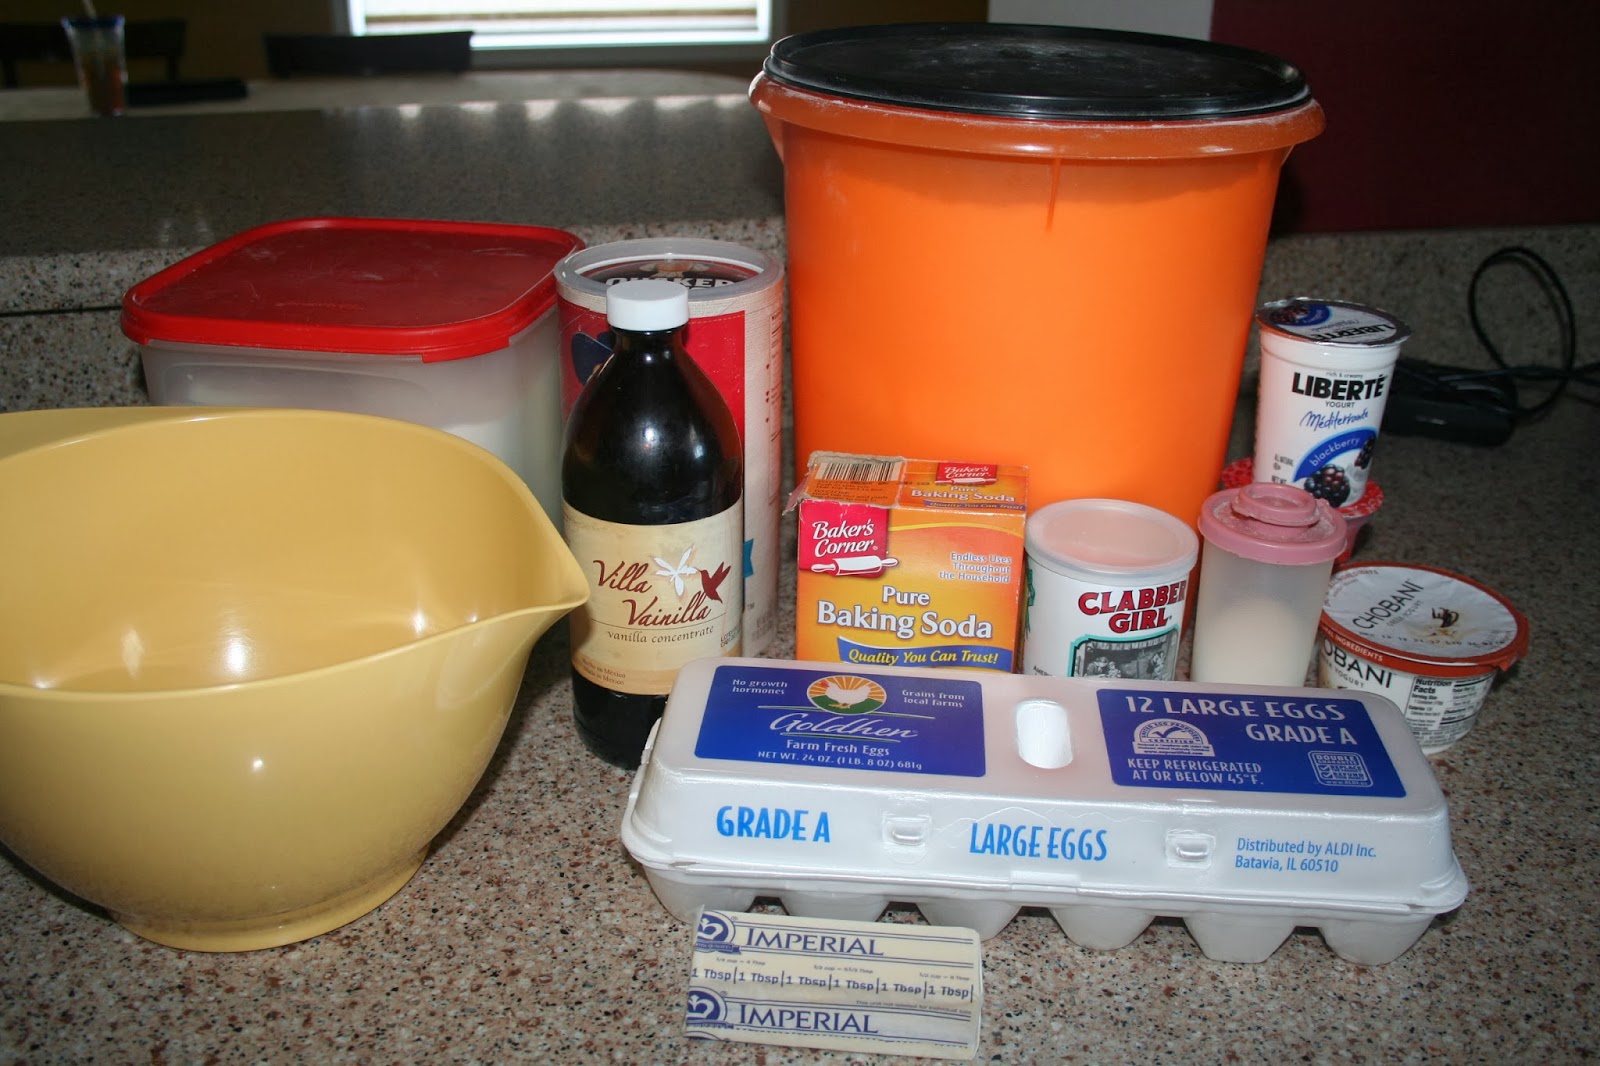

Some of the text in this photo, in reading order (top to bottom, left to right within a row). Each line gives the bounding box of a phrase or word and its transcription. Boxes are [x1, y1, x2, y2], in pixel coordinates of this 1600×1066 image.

[1291, 371, 1386, 400] LIBERTÉ
[1309, 438, 1360, 467] blackberry
[944, 465, 990, 474] Baker's
[945, 471, 988, 479] Corner
[911, 489, 1015, 502] Baking Soda
[950, 485, 978, 493] Pure
[811, 519, 875, 541] Baker's
[814, 538, 874, 558] Corner
[951, 552, 1012, 563] Endless Uses
[593, 560, 652, 594] Villa
[939, 571, 1010, 583] the Household
[953, 562, 1011, 573] Throughout
[882, 585, 930, 605] Pure
[1078, 580, 1187, 616] CLABBER
[1352, 580, 1425, 629] CHOBANI
[622, 590, 711, 627] Vainilla
[817, 600, 992, 640] Baking Soda
[1108, 608, 1168, 633] GIRL
[607, 630, 647, 643] vanilla
[651, 626, 714, 643] concentrate
[848, 649, 998, 666] Quality You Can Trust!
[1335, 635, 1383, 661] INGREDIENTS
[749, 679, 788, 688] growth
[1335, 668, 1365, 688] YOGURT
[1415, 678, 1452, 687] Nutrition
[732, 686, 785, 695] hormones
[902, 689, 965, 701] Grains from
[1413, 685, 1436, 694] Facts
[904, 697, 964, 708] local farms
[1125, 696, 1346, 721] 12 LARGE EGGS
[769, 713, 917, 738] Goldhen
[1245, 723, 1358, 745] GRADE A
[786, 739, 890, 757] Farm Fresh Eggs
[757, 751, 922, 770] NET WT. 24 OZ. (1 LB. 8 OZ) 681g
[1127, 758, 1262, 774] KEEP REFRIGERATED
[1132, 769, 1148, 780] AT
[1152, 770, 1171, 781] OR
[1176, 771, 1223, 784] BELOW
[716, 805, 831, 843] GRADE A
[970, 822, 1107, 861] LARGE EGGS
[1237, 837, 1377, 857] Distributed by ALDI Inc.
[1235, 855, 1339, 873] Batavia, IL 60510
[746, 928, 884, 956] IMPERIAL
[691, 967, 969, 999] 1 Tbsp 1 Tbsp 1 Tbsp 1 Tbsp 1 Tbsp 1 Tbsp
[740, 1004, 878, 1034] IMPERIAL
